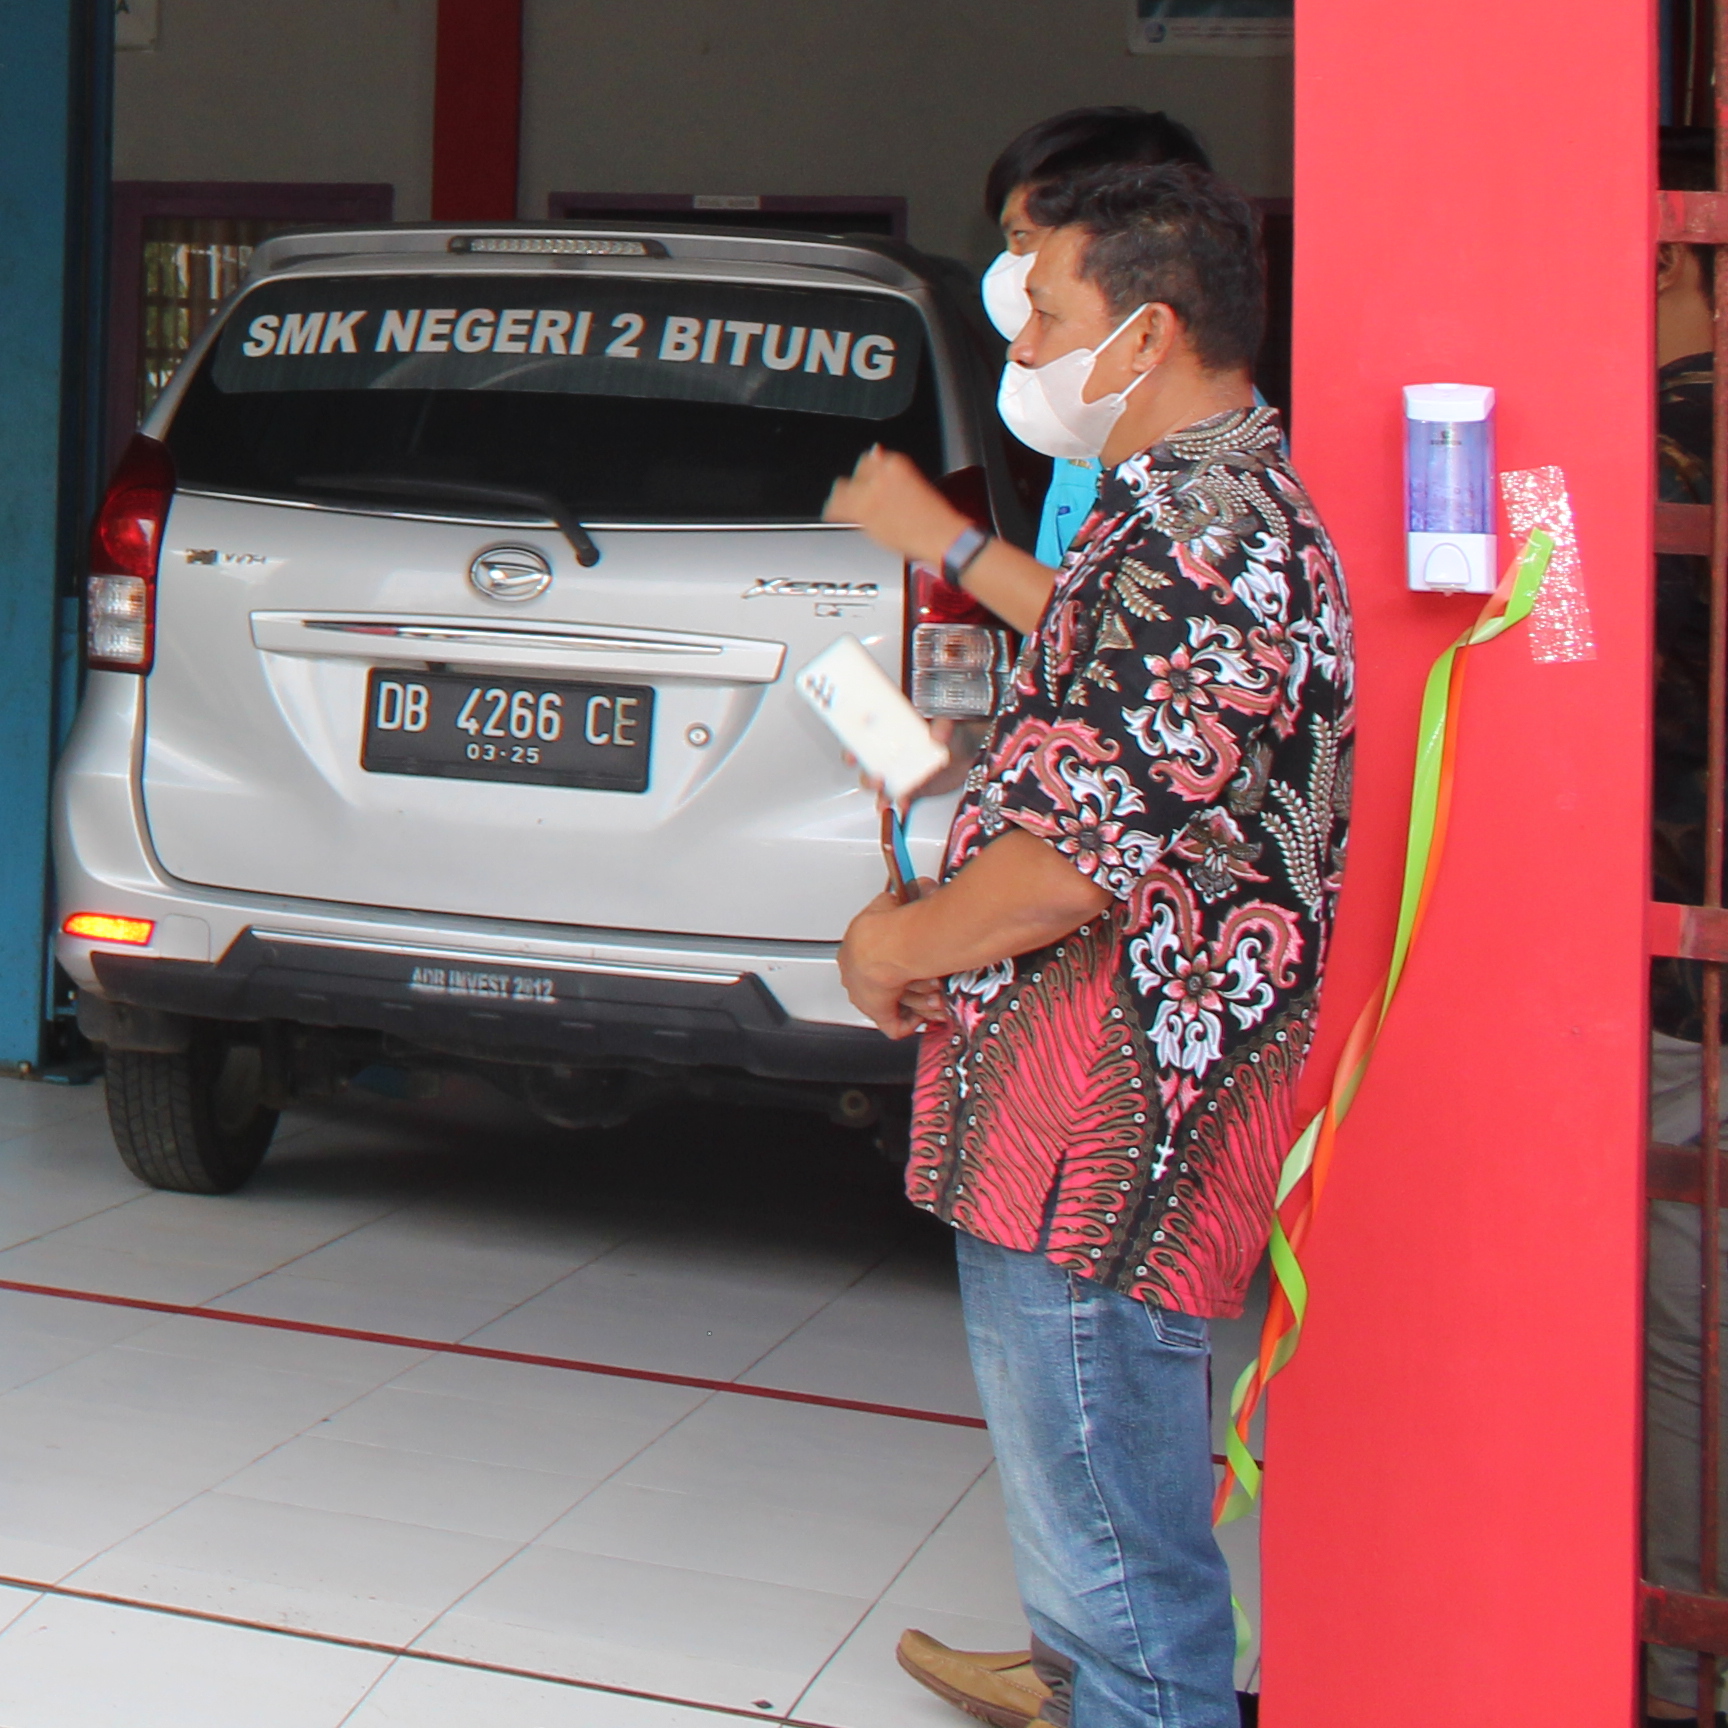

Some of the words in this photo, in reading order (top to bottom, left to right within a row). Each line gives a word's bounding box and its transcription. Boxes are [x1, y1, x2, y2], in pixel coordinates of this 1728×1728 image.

[243, 310, 367, 357] SMK
[374, 308, 592, 355] NEGERI
[604, 313, 644, 359] 2
[657, 315, 896, 381] BITUNG
[377, 681, 431, 732] DB
[456, 687, 564, 742] 4266
[585, 695, 639, 746] CE
[447, 969, 510, 998] INVEST
